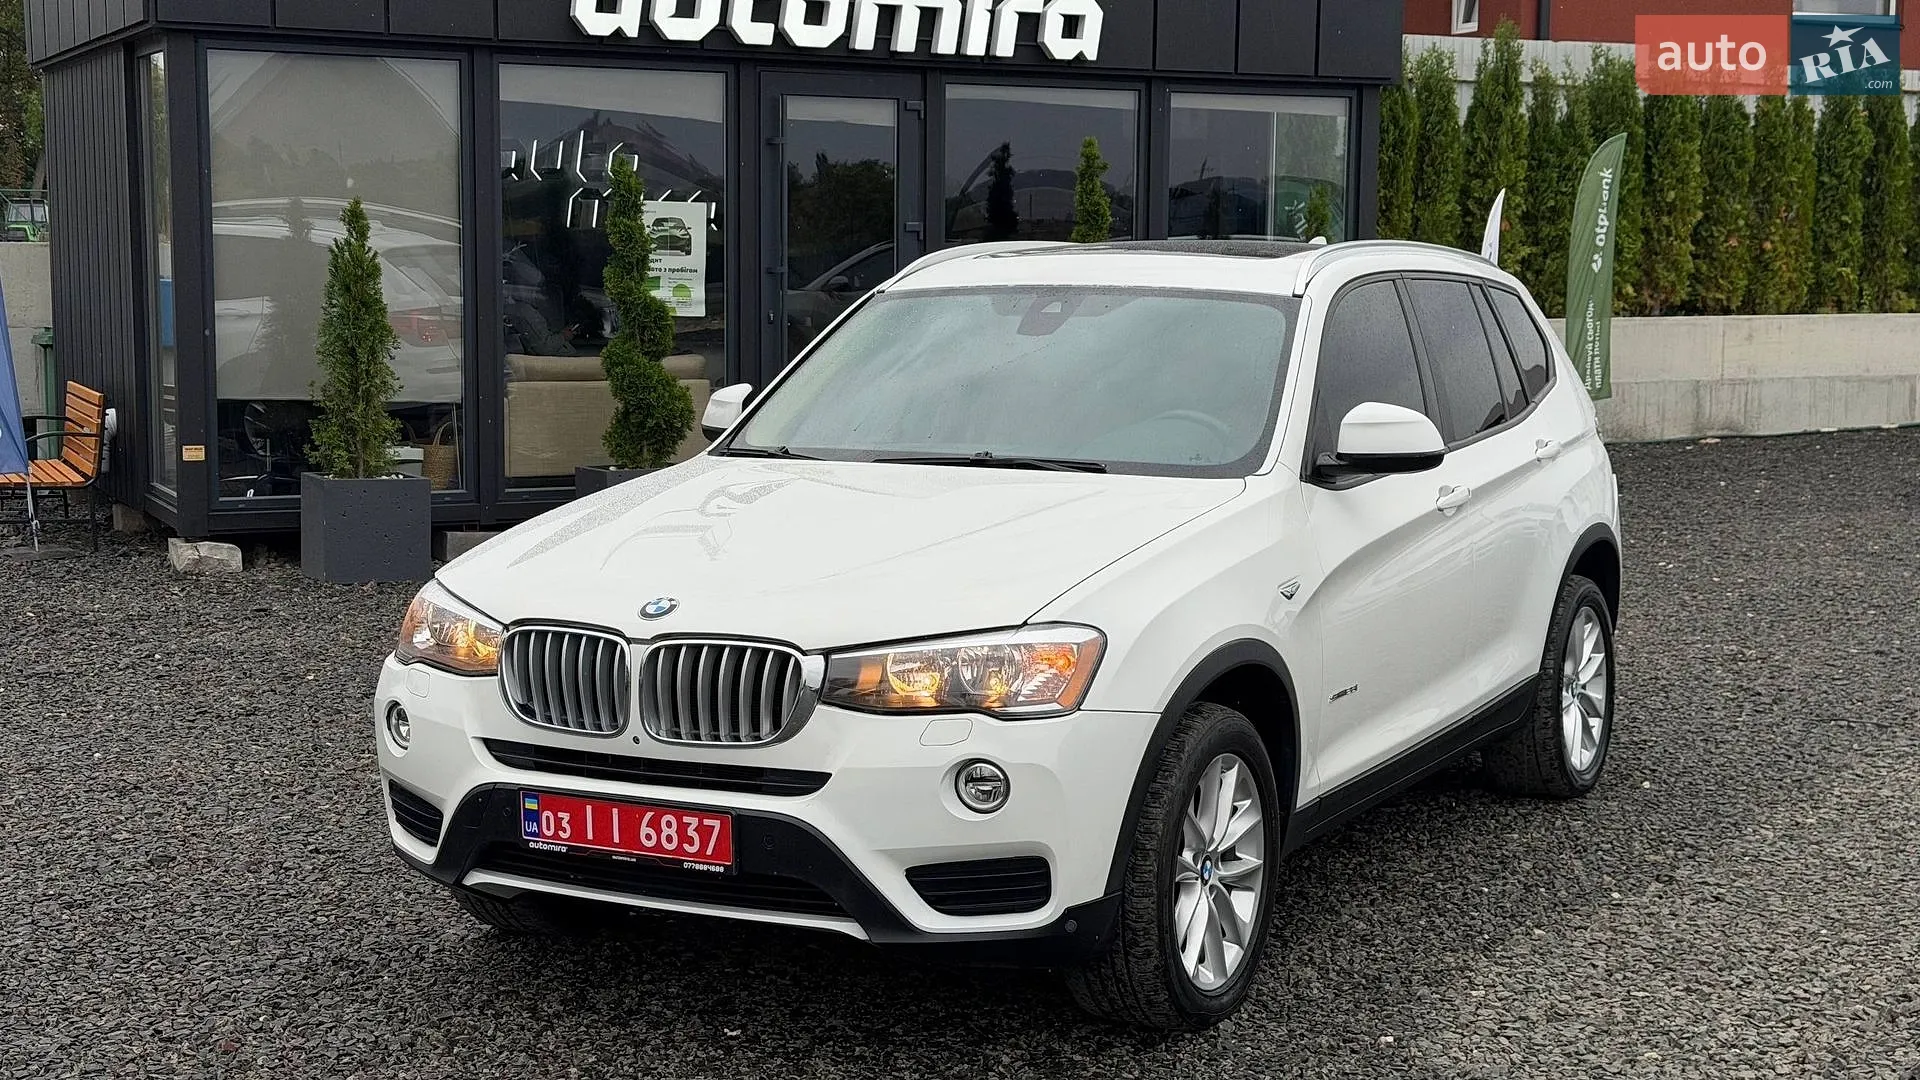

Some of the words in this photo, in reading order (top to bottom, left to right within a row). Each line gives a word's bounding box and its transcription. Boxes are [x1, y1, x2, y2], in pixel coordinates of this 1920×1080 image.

[525, 820, 539, 833] UA
[541, 810, 571, 839] 03
[639, 811, 721, 856] 6837
[529, 841, 568, 853] automira
